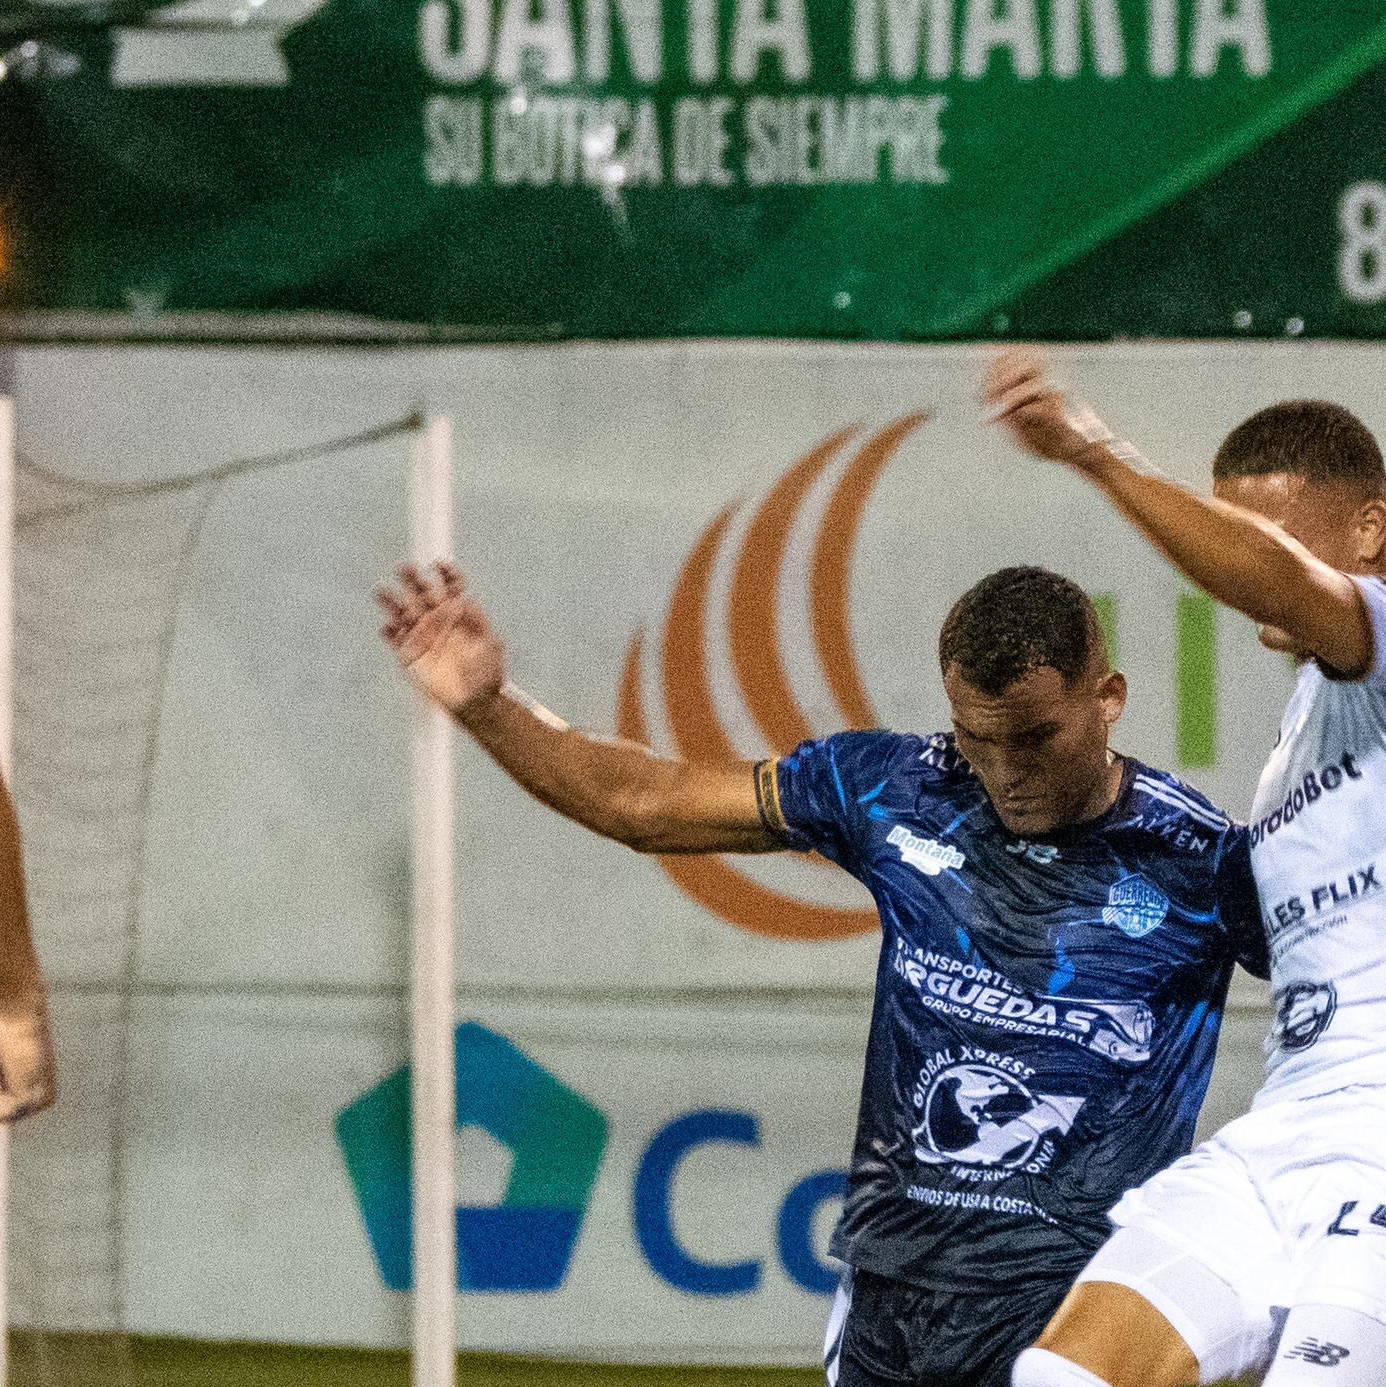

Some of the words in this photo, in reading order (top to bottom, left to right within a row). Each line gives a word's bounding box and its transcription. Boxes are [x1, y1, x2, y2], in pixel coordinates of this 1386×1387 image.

[424, 97, 483, 185] SU
[673, 97, 734, 186] DE
[746, 97, 950, 186] SIEMPRE
[1311, 863, 1382, 911] FLIX
[896, 935, 1025, 995] TRANSPORTES
[921, 995, 972, 1019] GRUPO
[973, 1011, 1087, 1047] EMPRESARIAL
[913, 1048, 956, 1109] GLOBAL
[959, 1045, 1036, 1081] XPRESS
